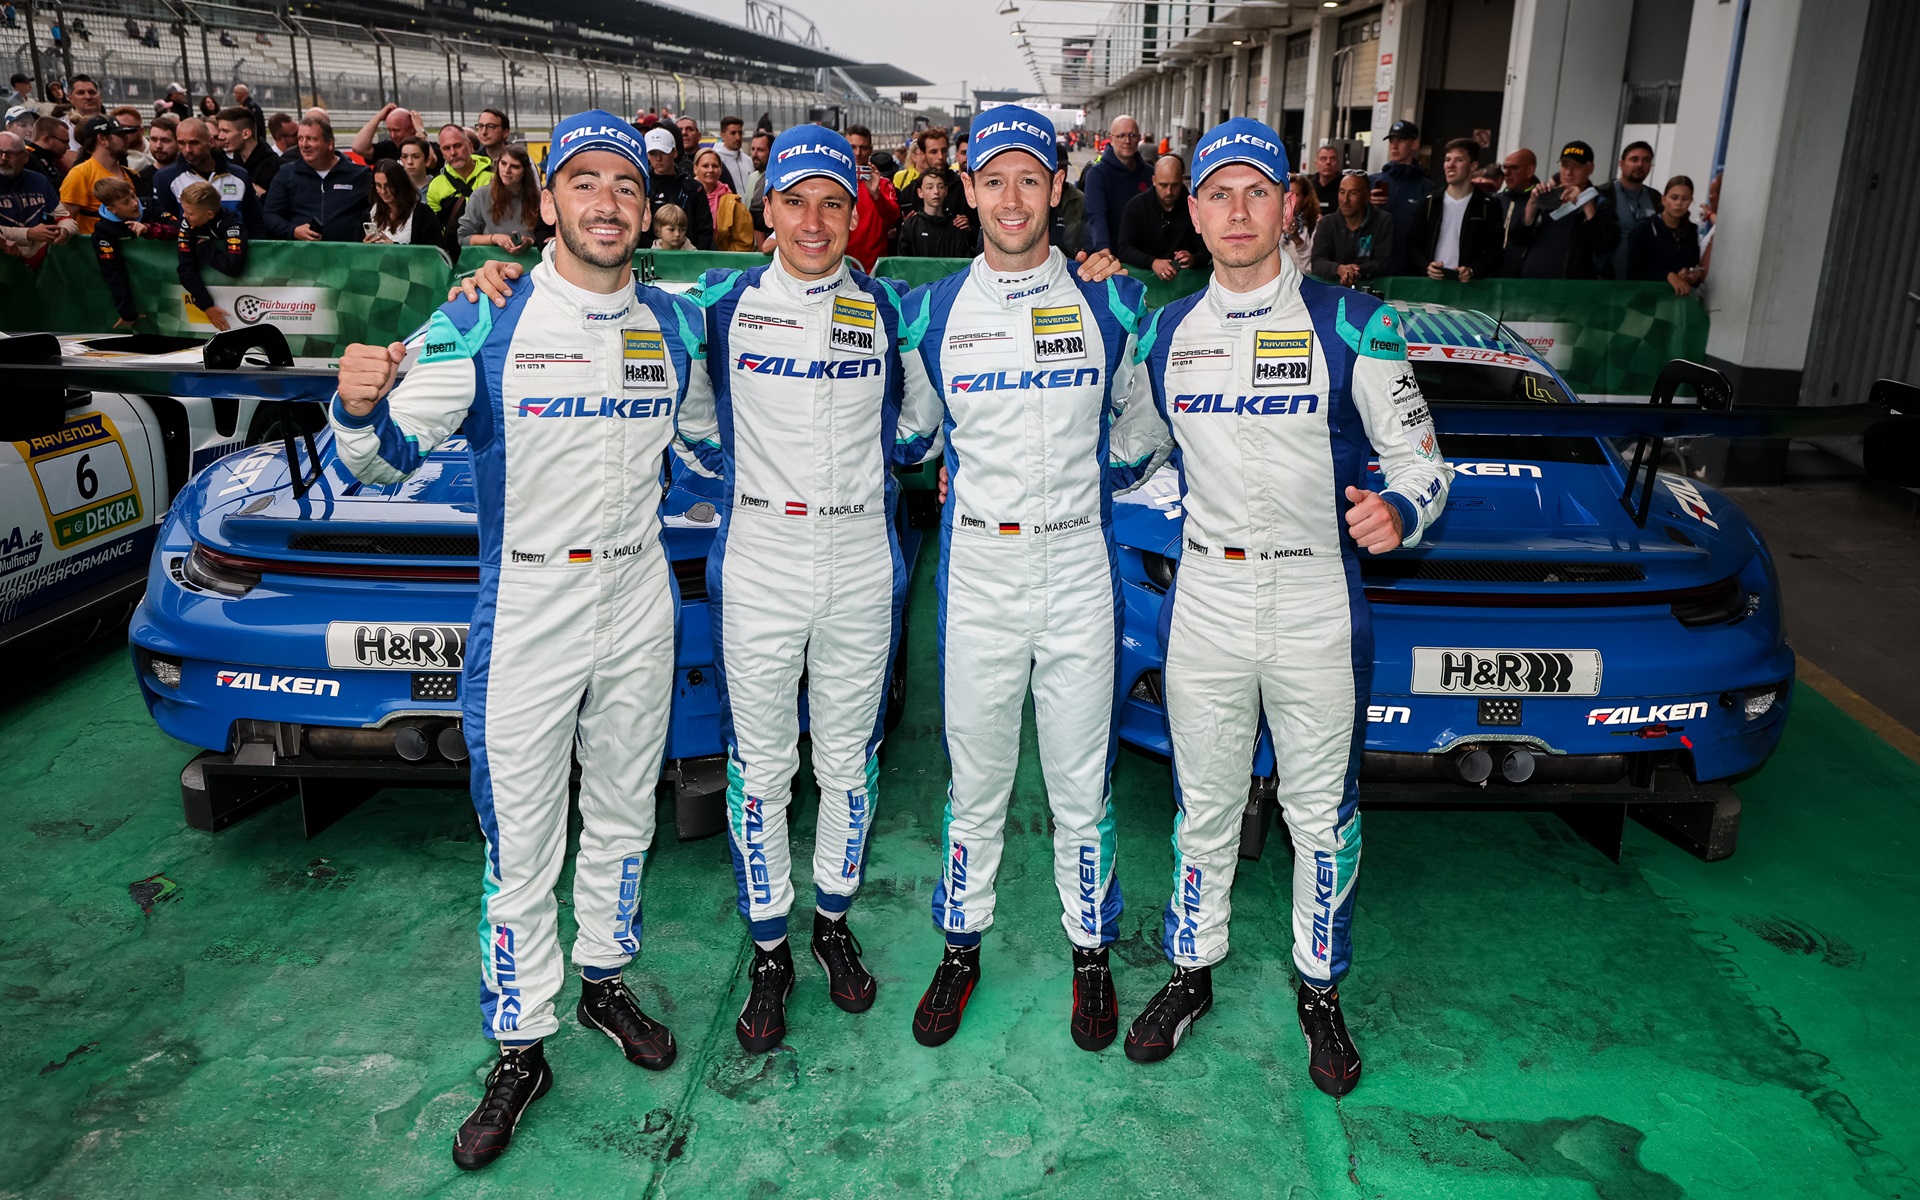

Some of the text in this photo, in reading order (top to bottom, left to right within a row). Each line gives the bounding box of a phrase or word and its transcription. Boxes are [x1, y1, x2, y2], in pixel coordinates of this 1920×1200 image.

[559, 126, 642, 155] FALKEN
[977, 121, 1052, 146] FALKEN
[1199, 134, 1279, 162] FALKEN
[1563, 146, 1585, 156] DTM
[777, 144, 853, 170] FALKEN
[806, 279, 843, 296] FALKEN
[1006, 284, 1049, 301] FALKEN
[259, 301, 316, 312] nürburgring
[586, 307, 630, 321] FALKEN
[837, 306, 871, 318] RAVENOL
[1226, 307, 1272, 319] FALKEN
[265, 314, 299, 322] LANGSTRECKEN
[739, 312, 797, 325] PORSCHE
[1037, 316, 1075, 326] RAVENOL
[627, 341, 661, 350] RAVENOL
[832, 327, 857, 347] H&R
[949, 332, 1006, 342] PORSCHE
[1262, 341, 1304, 349] RAVENOL
[1370, 337, 1400, 352] freem
[425, 341, 457, 357] freem
[515, 352, 584, 361] PORSCHE
[1036, 340, 1064, 356] H&R
[1172, 348, 1224, 358] PORSCHE
[735, 352, 882, 380] FALKEN
[1451, 352, 1532, 368] auto
[625, 364, 650, 382] H&R
[1256, 363, 1287, 380] H&R
[949, 367, 1100, 395] FALKEN
[513, 397, 673, 419] FALKEN
[1171, 393, 1319, 415] FALKEN
[30, 422, 104, 451] RAVENOL
[76, 453, 99, 500] 6
[741, 493, 865, 516] freem K. BACHLER
[85, 503, 137, 535] DEKRA
[961, 514, 1090, 534] freem D. MARSCHALL
[511, 549, 546, 563] freem
[603, 550, 612, 559] S.
[1260, 551, 1272, 561] N.
[1274, 547, 1314, 559] MENZEL
[355, 626, 446, 667] H&R
[1440, 652, 1530, 692] H&R
[215, 670, 340, 697] FALKEN
[1585, 701, 1709, 726] FALKEN
[745, 794, 772, 905] FALKEN
[613, 857, 640, 956] ALKEN
[495, 921, 521, 1032] FALKE
